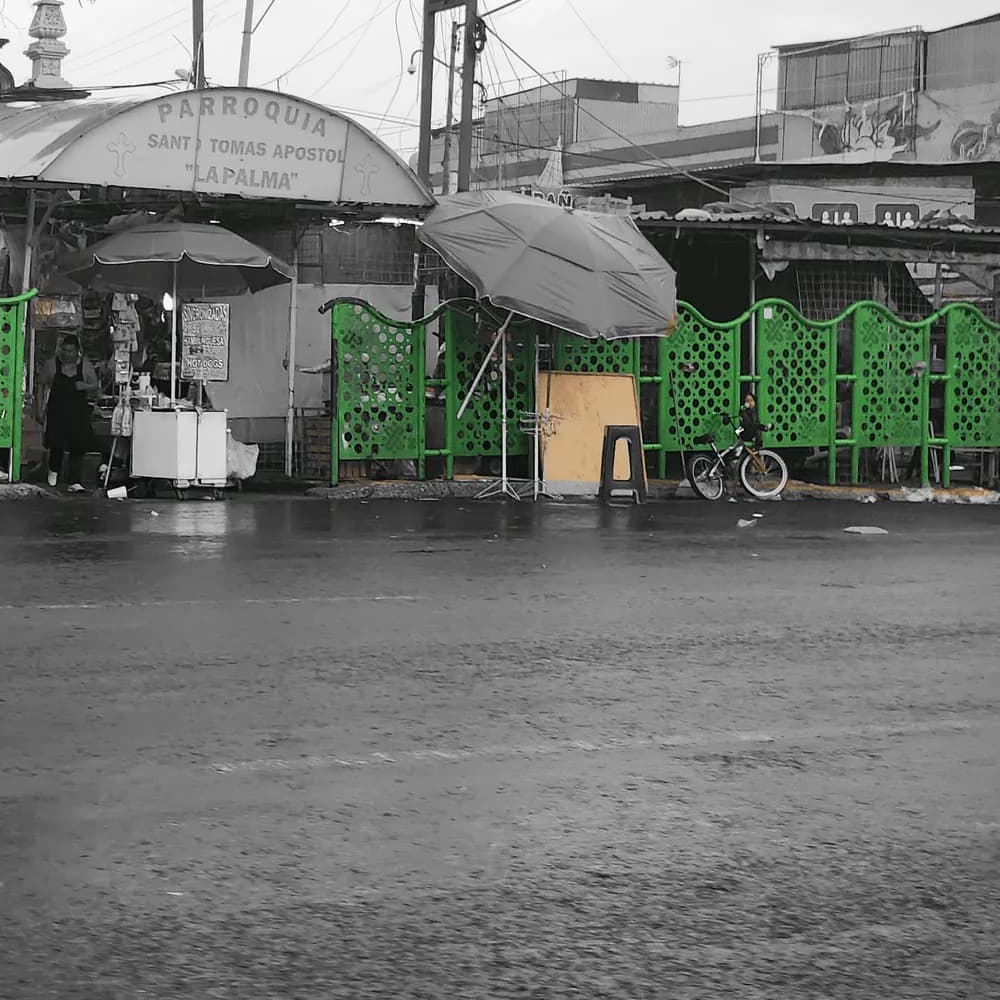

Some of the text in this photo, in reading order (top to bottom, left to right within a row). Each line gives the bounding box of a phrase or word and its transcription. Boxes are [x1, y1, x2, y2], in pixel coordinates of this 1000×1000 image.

[157, 95, 326, 137] PARROQUIA
[209, 138, 267, 157] TOMAS
[272, 144, 345, 164] APOSTOL
